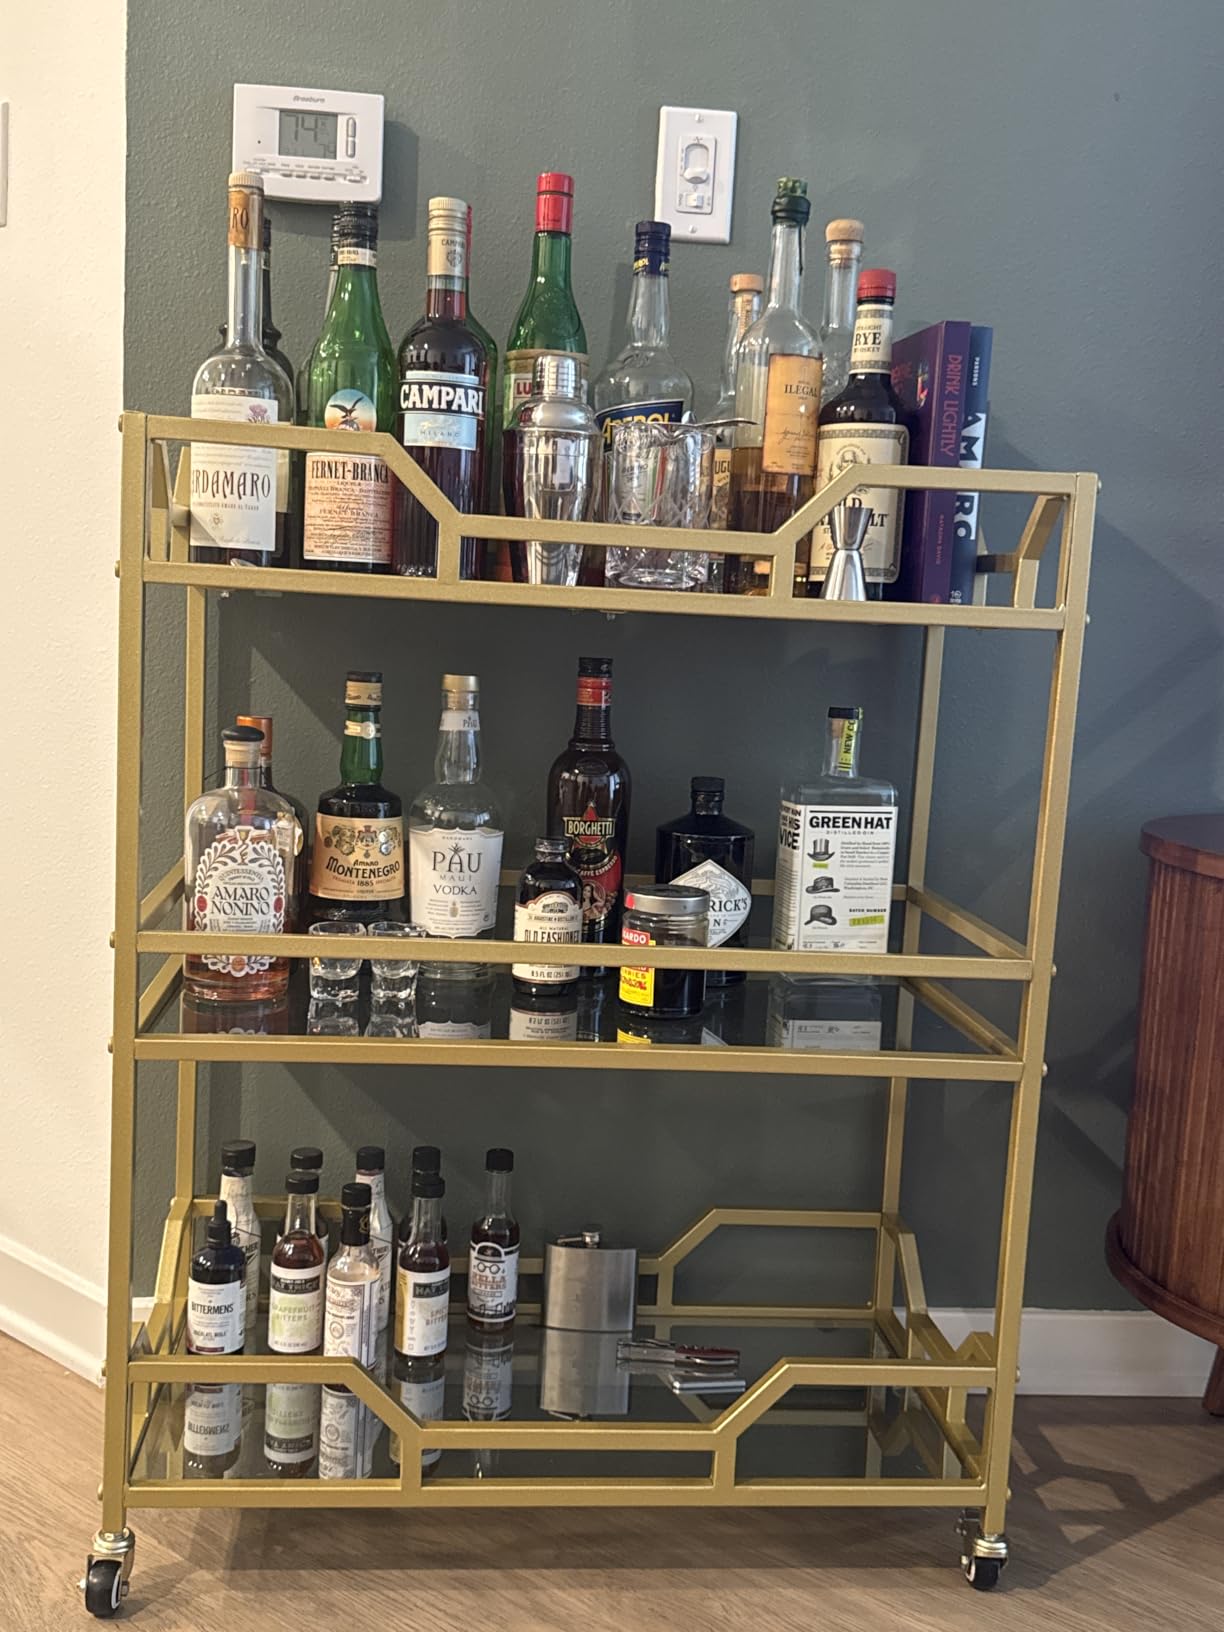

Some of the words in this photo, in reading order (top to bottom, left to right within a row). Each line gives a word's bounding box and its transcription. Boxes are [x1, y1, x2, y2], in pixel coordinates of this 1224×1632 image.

[854, 332, 882, 346] RYE
[944, 354, 963, 395] DRINK
[783, 383, 818, 398] ILEGAL
[400, 384, 484, 414] CAMPARI
[940, 400, 960, 457] LIGHTLY
[843, 733, 854, 754] NEW
[568, 820, 613, 835] BORGHETTI
[809, 815, 862, 829] GREEN
[864, 816, 893, 829] HAT
[326, 856, 400, 879] MONTENEGRO
[432, 848, 483, 874] PAU
[357, 879, 374, 887] 1885
[433, 884, 477, 896] VODKA
[212, 885, 270, 901] AMARO
[211, 900, 270, 916] NONINO
[191, 1301, 234, 1315] BITTERMENS
